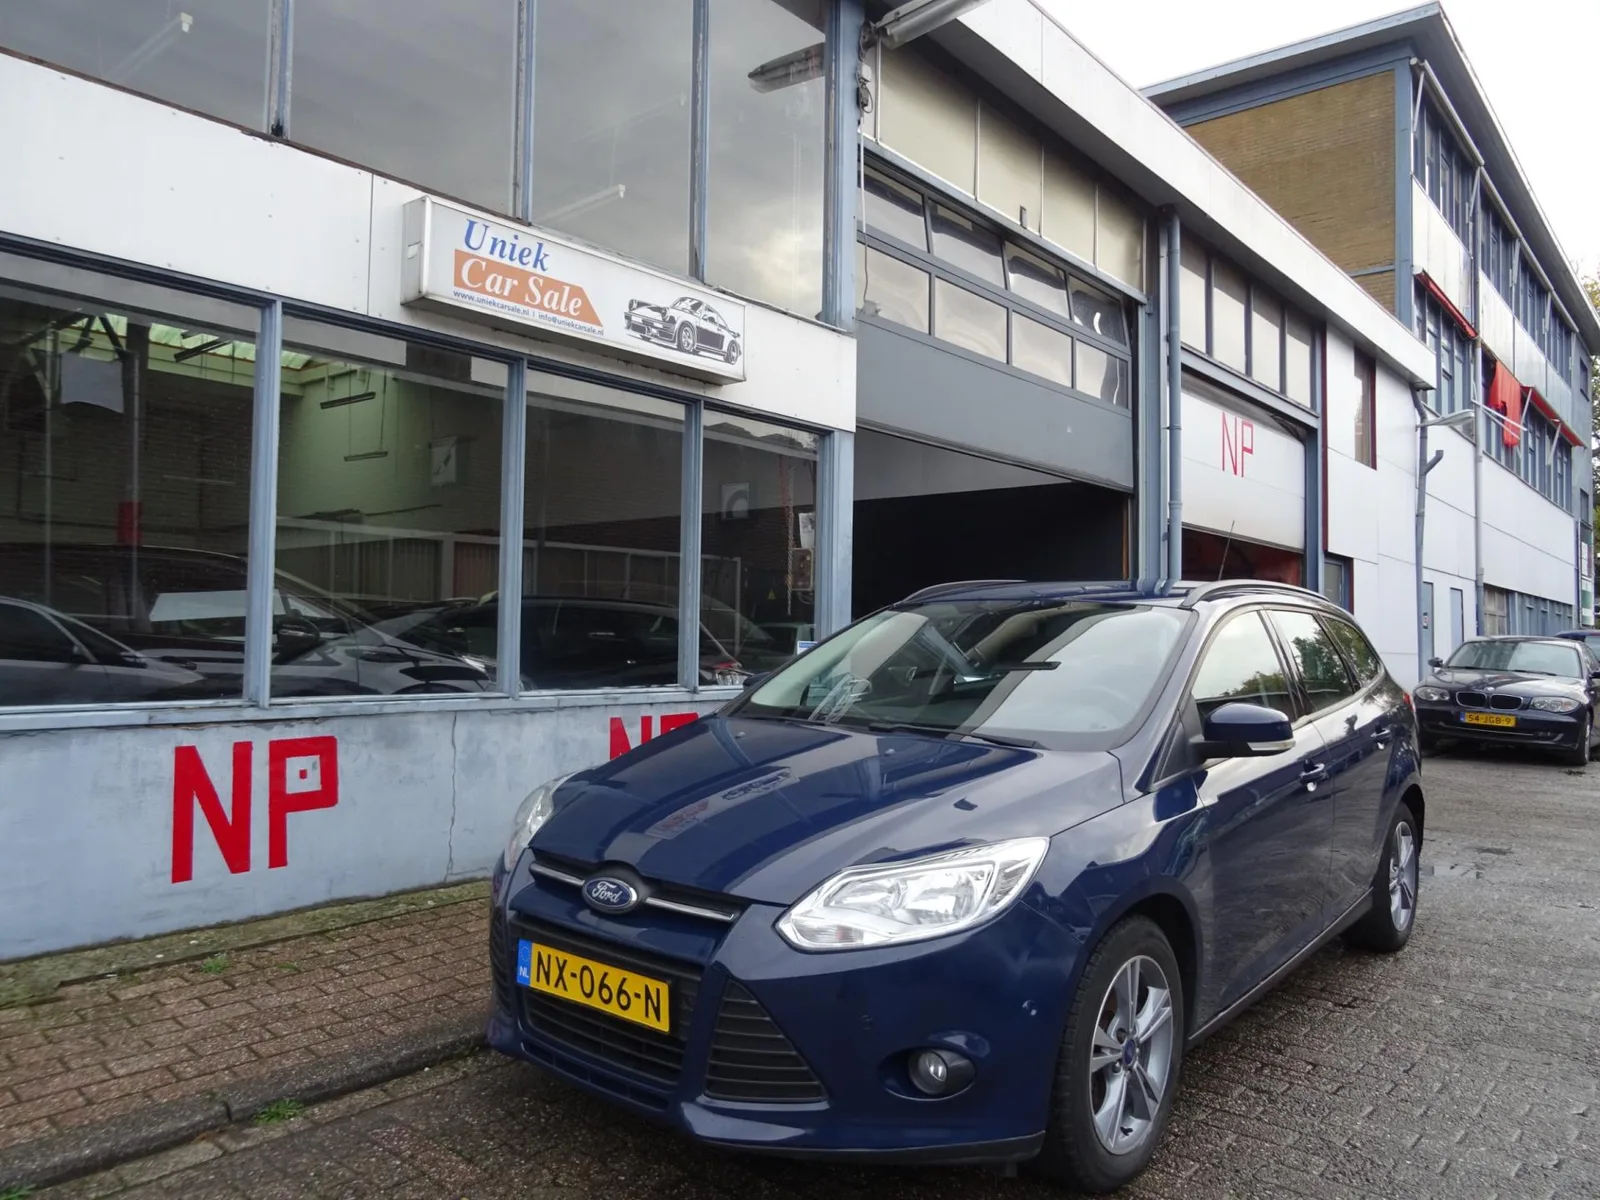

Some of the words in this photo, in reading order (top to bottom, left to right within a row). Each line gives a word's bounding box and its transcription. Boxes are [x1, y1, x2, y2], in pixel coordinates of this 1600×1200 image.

[463, 218, 550, 272] Uniek
[453, 290, 530, 316] www.uniekcarsale.nl
[538, 312, 604, 337] info@uniekcarsale.nl
[460, 257, 519, 297] Car
[524, 276, 583, 317] Sale
[1222, 411, 1254, 478] NP
[1468, 713, 1512, 726] 54-JGB-9
[171, 735, 339, 884] NP
[591, 880, 621, 903] Ford
[519, 965, 530, 979] NL
[535, 950, 662, 1023] NX-066-N
